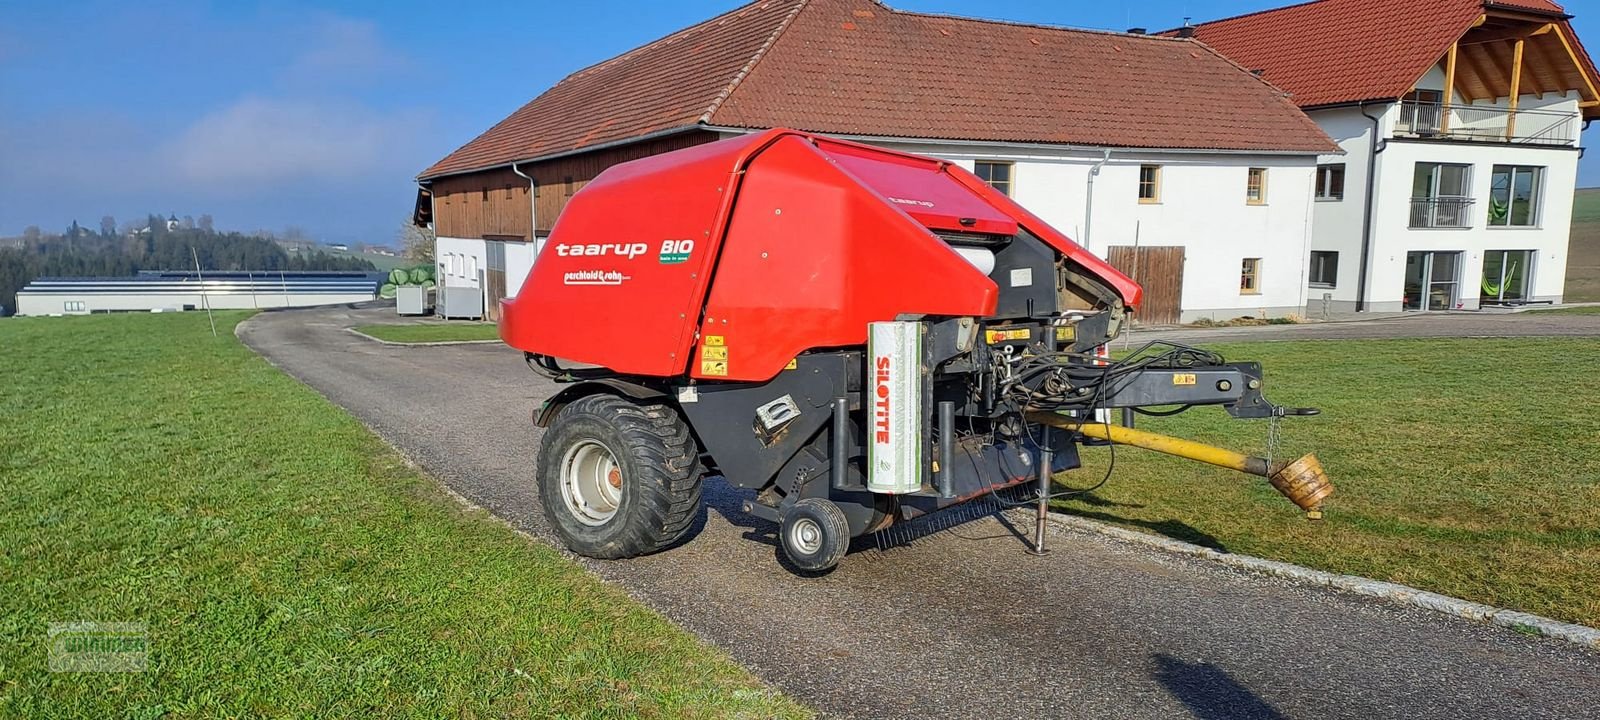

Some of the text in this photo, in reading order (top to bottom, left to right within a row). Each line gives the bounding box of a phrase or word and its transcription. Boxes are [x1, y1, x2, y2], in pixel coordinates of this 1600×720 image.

[888, 197, 934, 207] taarup
[555, 243, 648, 259] taarup
[660, 239, 694, 254] BIO
